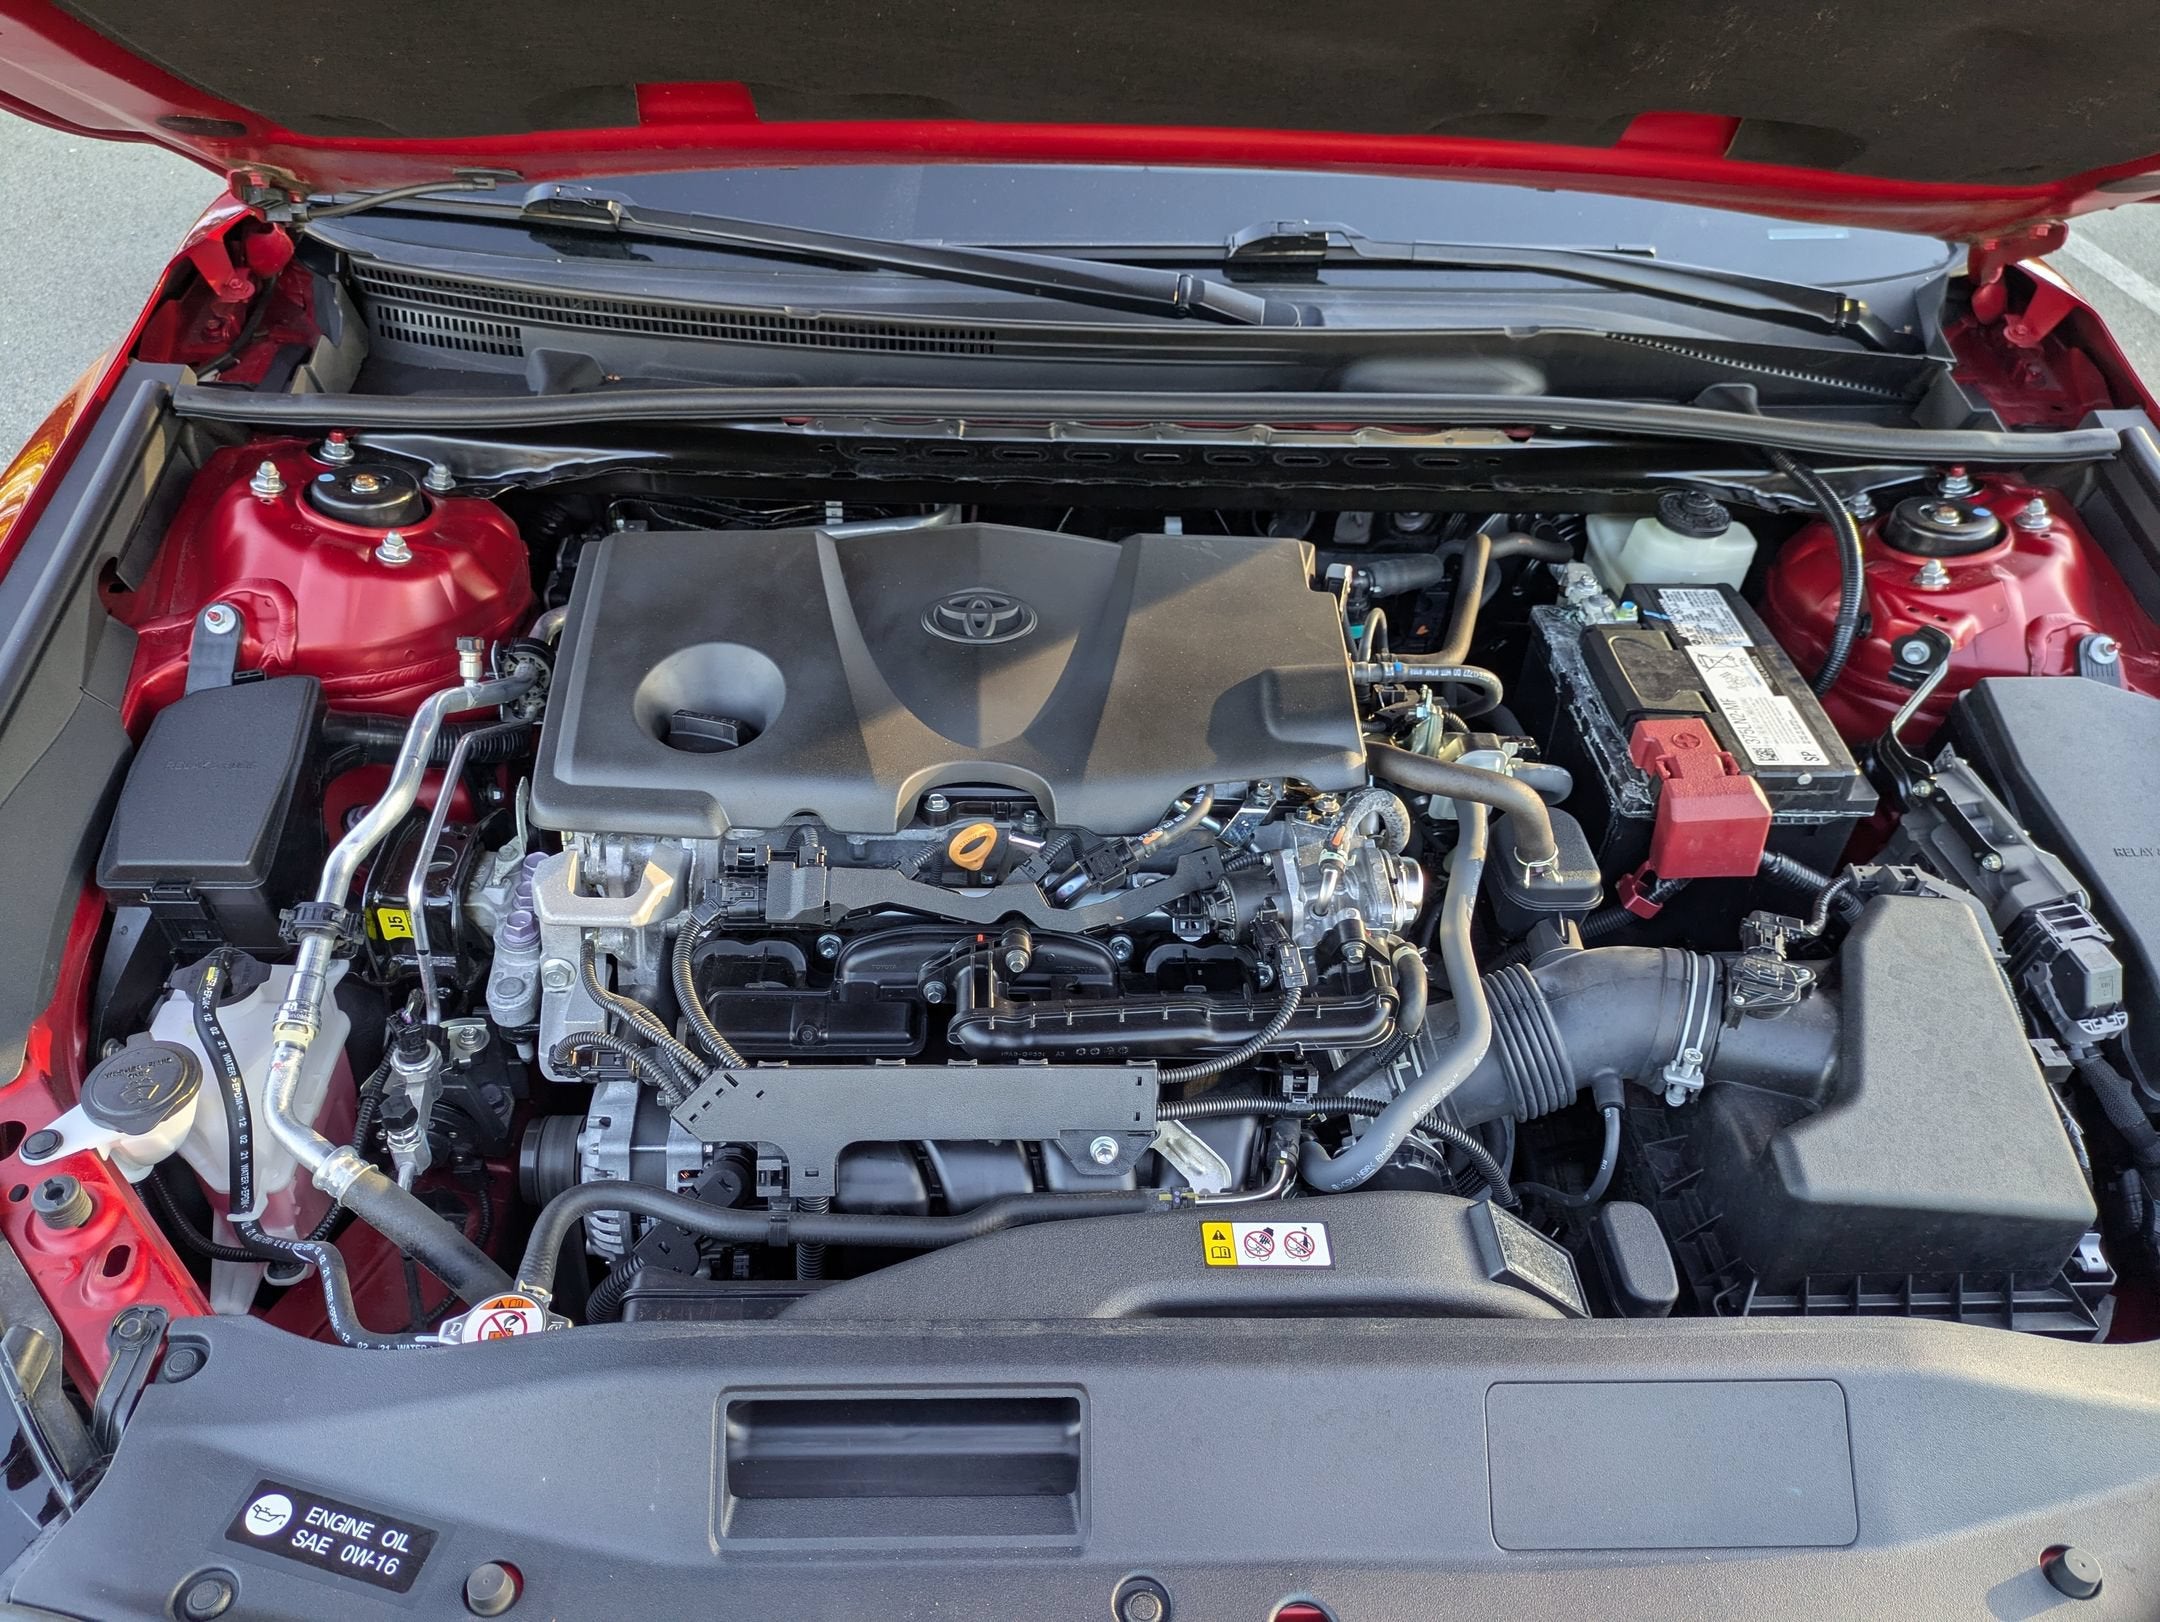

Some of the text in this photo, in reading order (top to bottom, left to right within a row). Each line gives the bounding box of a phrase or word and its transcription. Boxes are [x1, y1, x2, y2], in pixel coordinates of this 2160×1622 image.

[2113, 847, 2154, 857] RELAY
[387, 915, 406, 931] J5
[222, 1052, 237, 1077] WATER
[238, 1116, 247, 1128] 12
[239, 1134, 248, 1145] 02
[240, 1151, 249, 1160] 21
[305, 1506, 409, 1553] ENGINE OIL
[291, 1529, 399, 1575] SAE 0W-16
